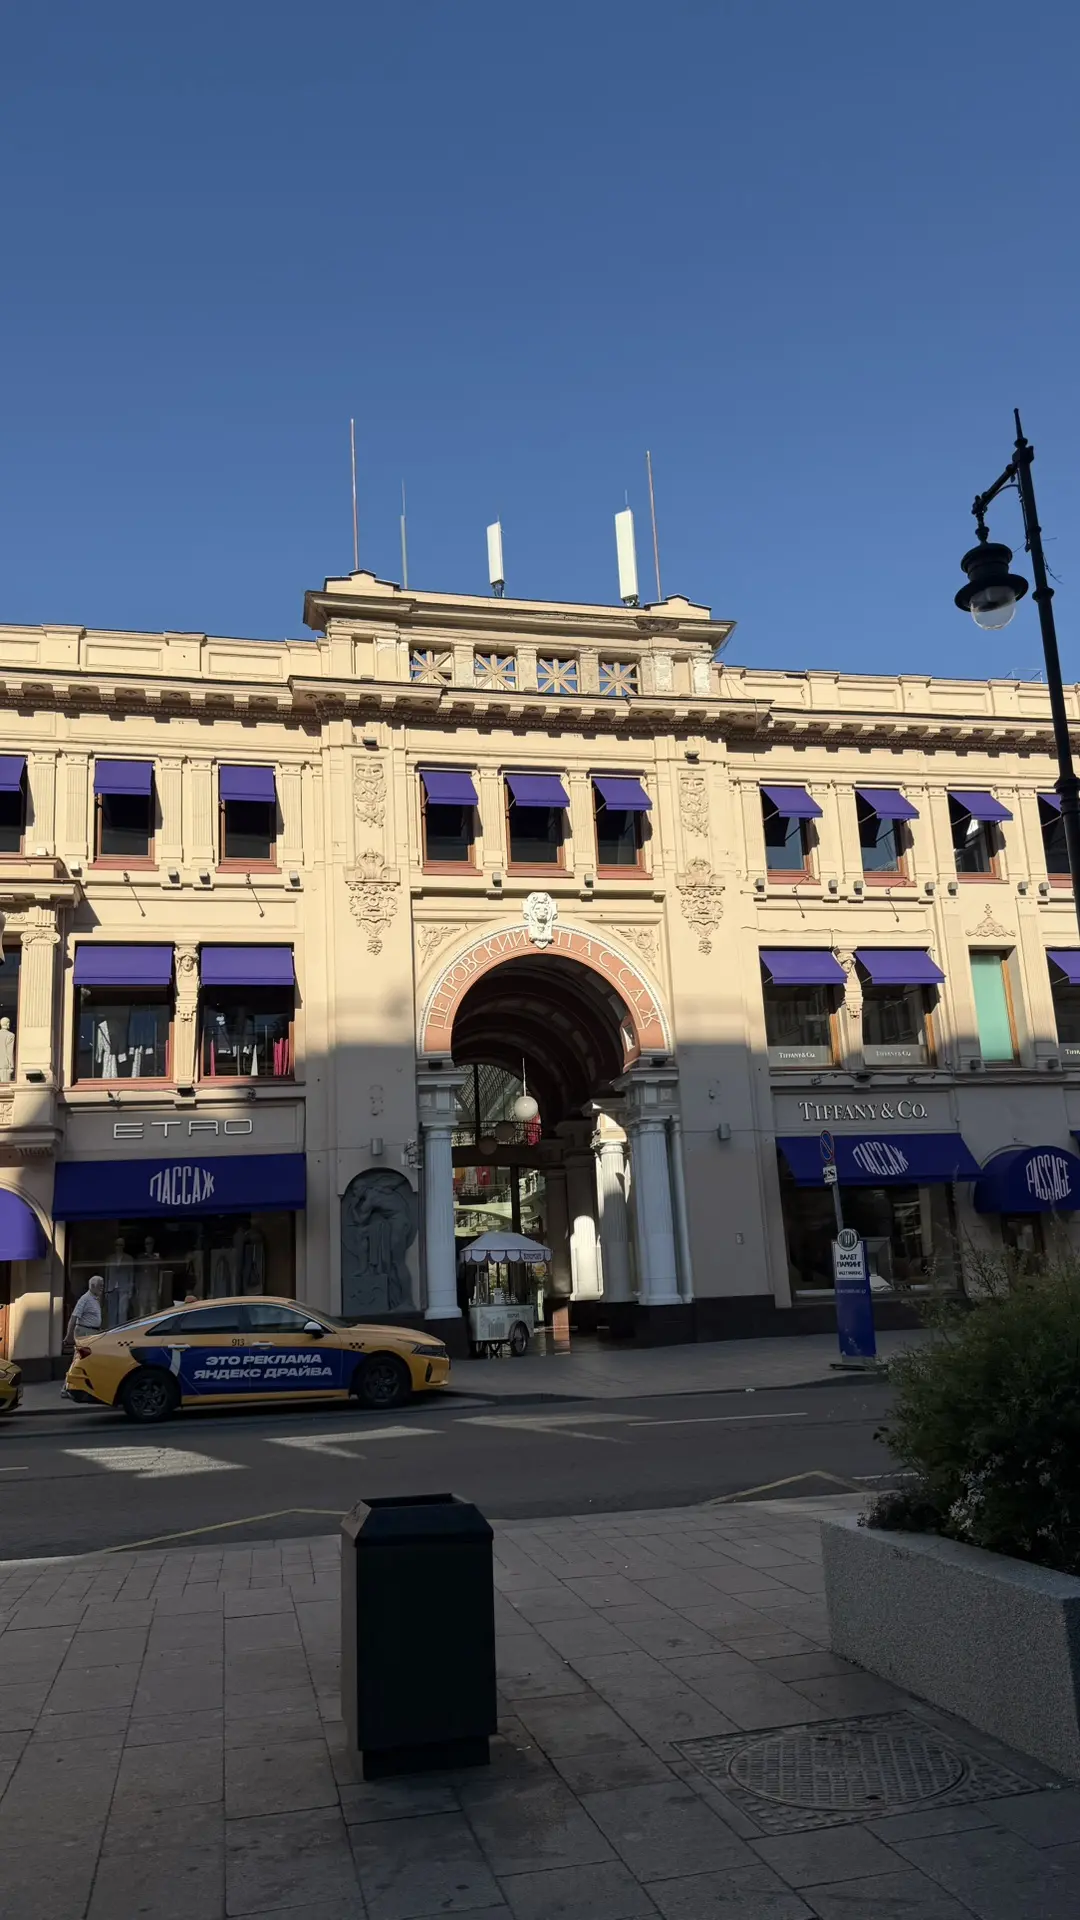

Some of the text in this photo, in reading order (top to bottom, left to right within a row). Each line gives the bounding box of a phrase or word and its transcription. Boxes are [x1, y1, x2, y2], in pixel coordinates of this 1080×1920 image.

[427, 929, 661, 1029] ПЕТРОВСКИЙ ПАССАЖ
[798, 1101, 878, 1121] TIFFANY
[880, 1102, 895, 1119] &
[113, 1118, 253, 1140] ETRO
[852, 1141, 909, 1176] ПАССАЖ
[149, 1165, 215, 1205] ПАССАЖ
[1025, 1153, 1073, 1202] PASSAGE
[840, 1253, 858, 1261] ВАЛЕТ
[231, 1338, 245, 1347] 913
[205, 1353, 322, 1365] ЭТО РЕКЛАМА
[193, 1364, 333, 1380] ЯНДЕКС ДРАЙВА
